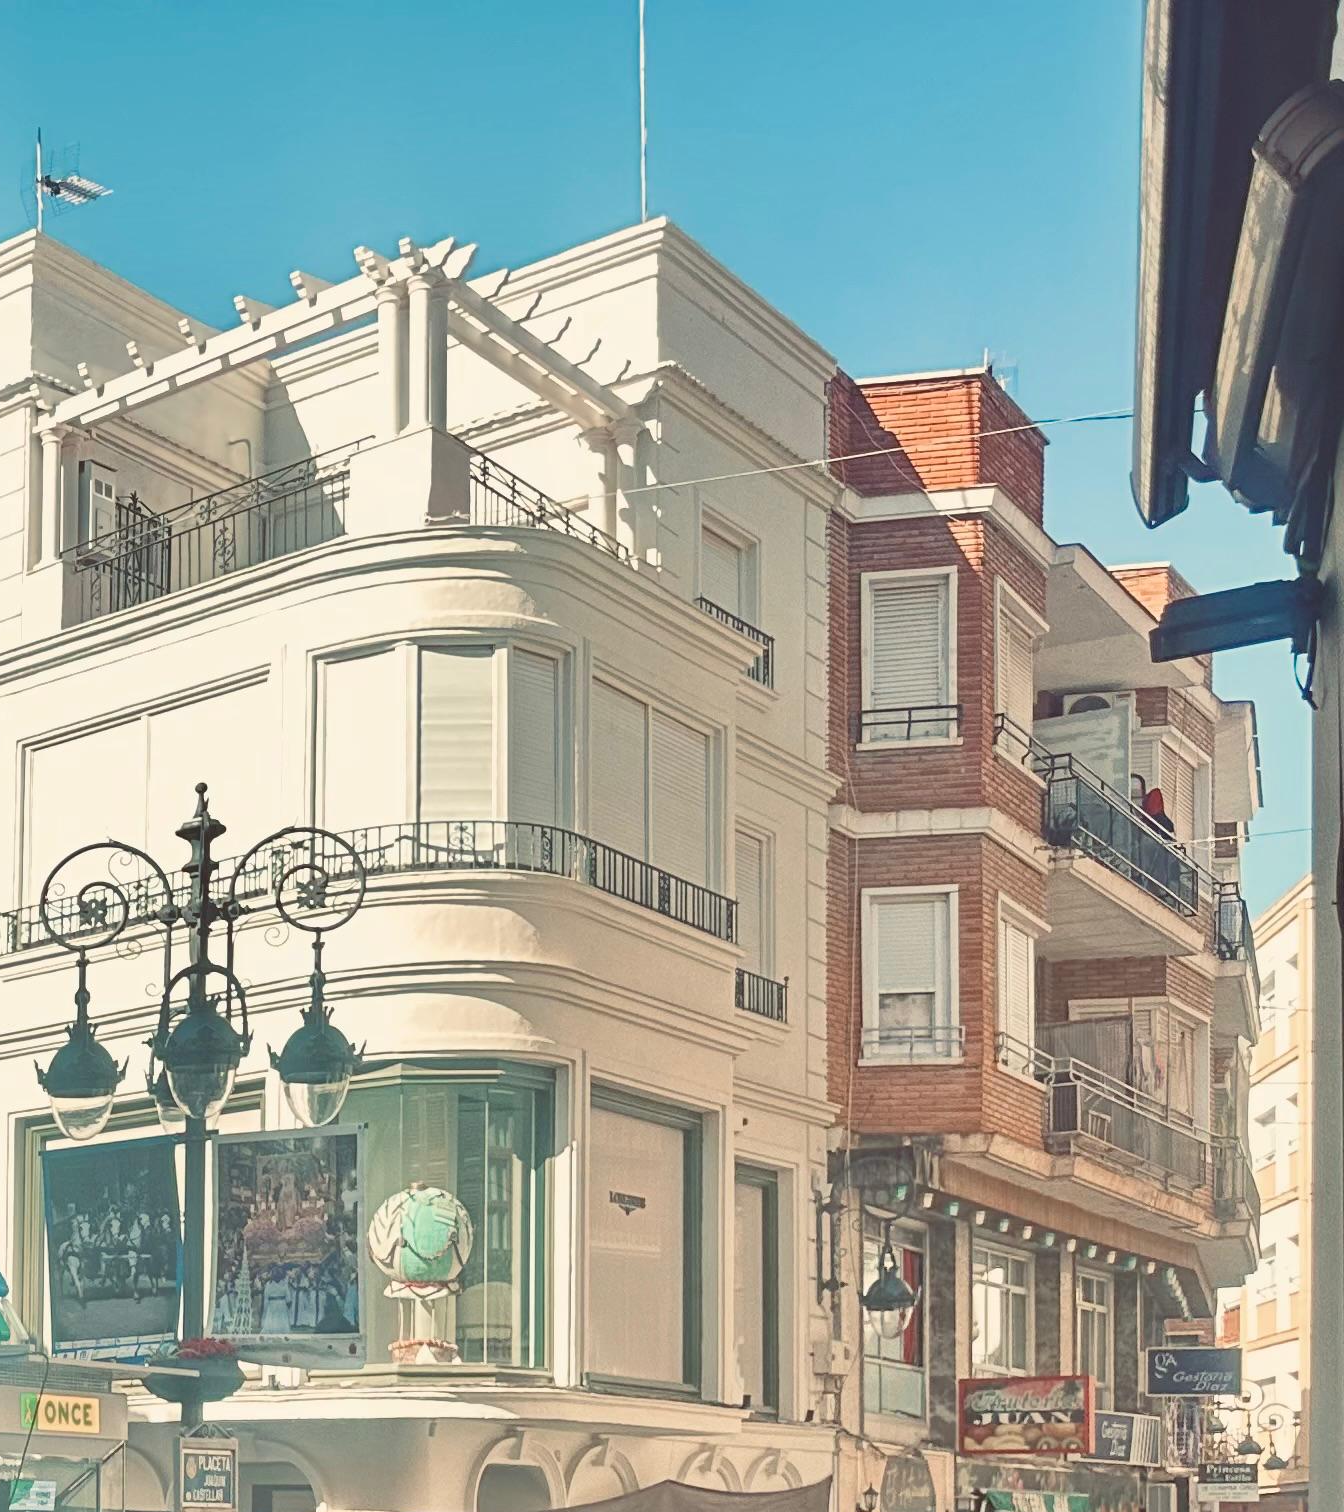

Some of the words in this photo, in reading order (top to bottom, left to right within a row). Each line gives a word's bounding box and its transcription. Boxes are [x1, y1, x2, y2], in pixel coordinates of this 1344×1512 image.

[44, 1403, 93, 1426] ONCE
[973, 1411, 1072, 1425] JUAN
[198, 1455, 231, 1471] PLACETA
